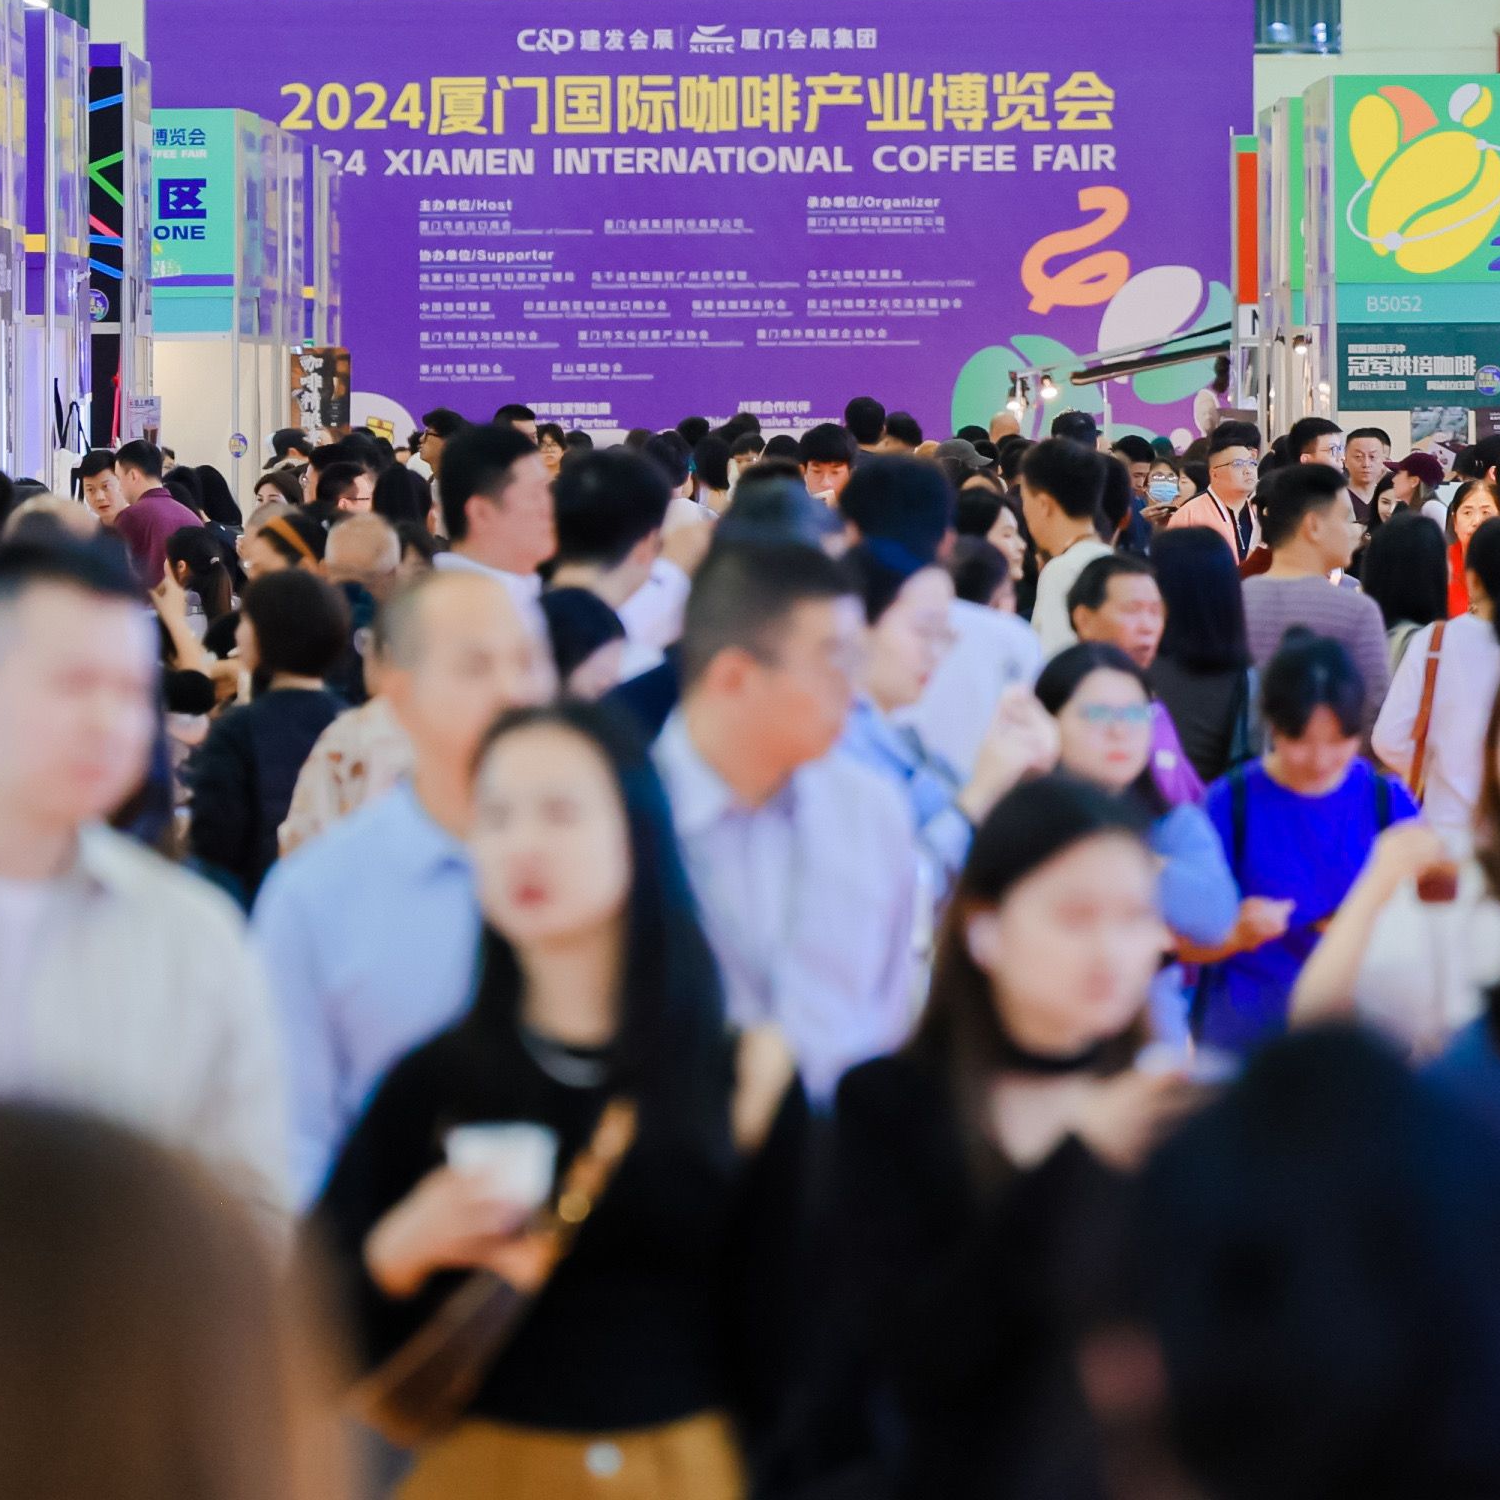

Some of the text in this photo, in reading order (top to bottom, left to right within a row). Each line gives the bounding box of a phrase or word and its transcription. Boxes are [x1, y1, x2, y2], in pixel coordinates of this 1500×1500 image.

[517, 28, 673, 54] C&D 建发会展
[741, 28, 876, 50] 厦门会展集团
[274, 71, 1115, 140] 2024厦门国际咖啡产业博览会
[384, 144, 1116, 175] XIAMEN INTERNATIONAL COFFEE FAIR
[158, 178, 207, 219] 区
[418, 198, 514, 213] 主办单位/Host
[806, 195, 942, 210] 承办单位/Organizer
[418, 249, 555, 263] 协办单位/Supporter
[1366, 295, 1423, 314] B5052
